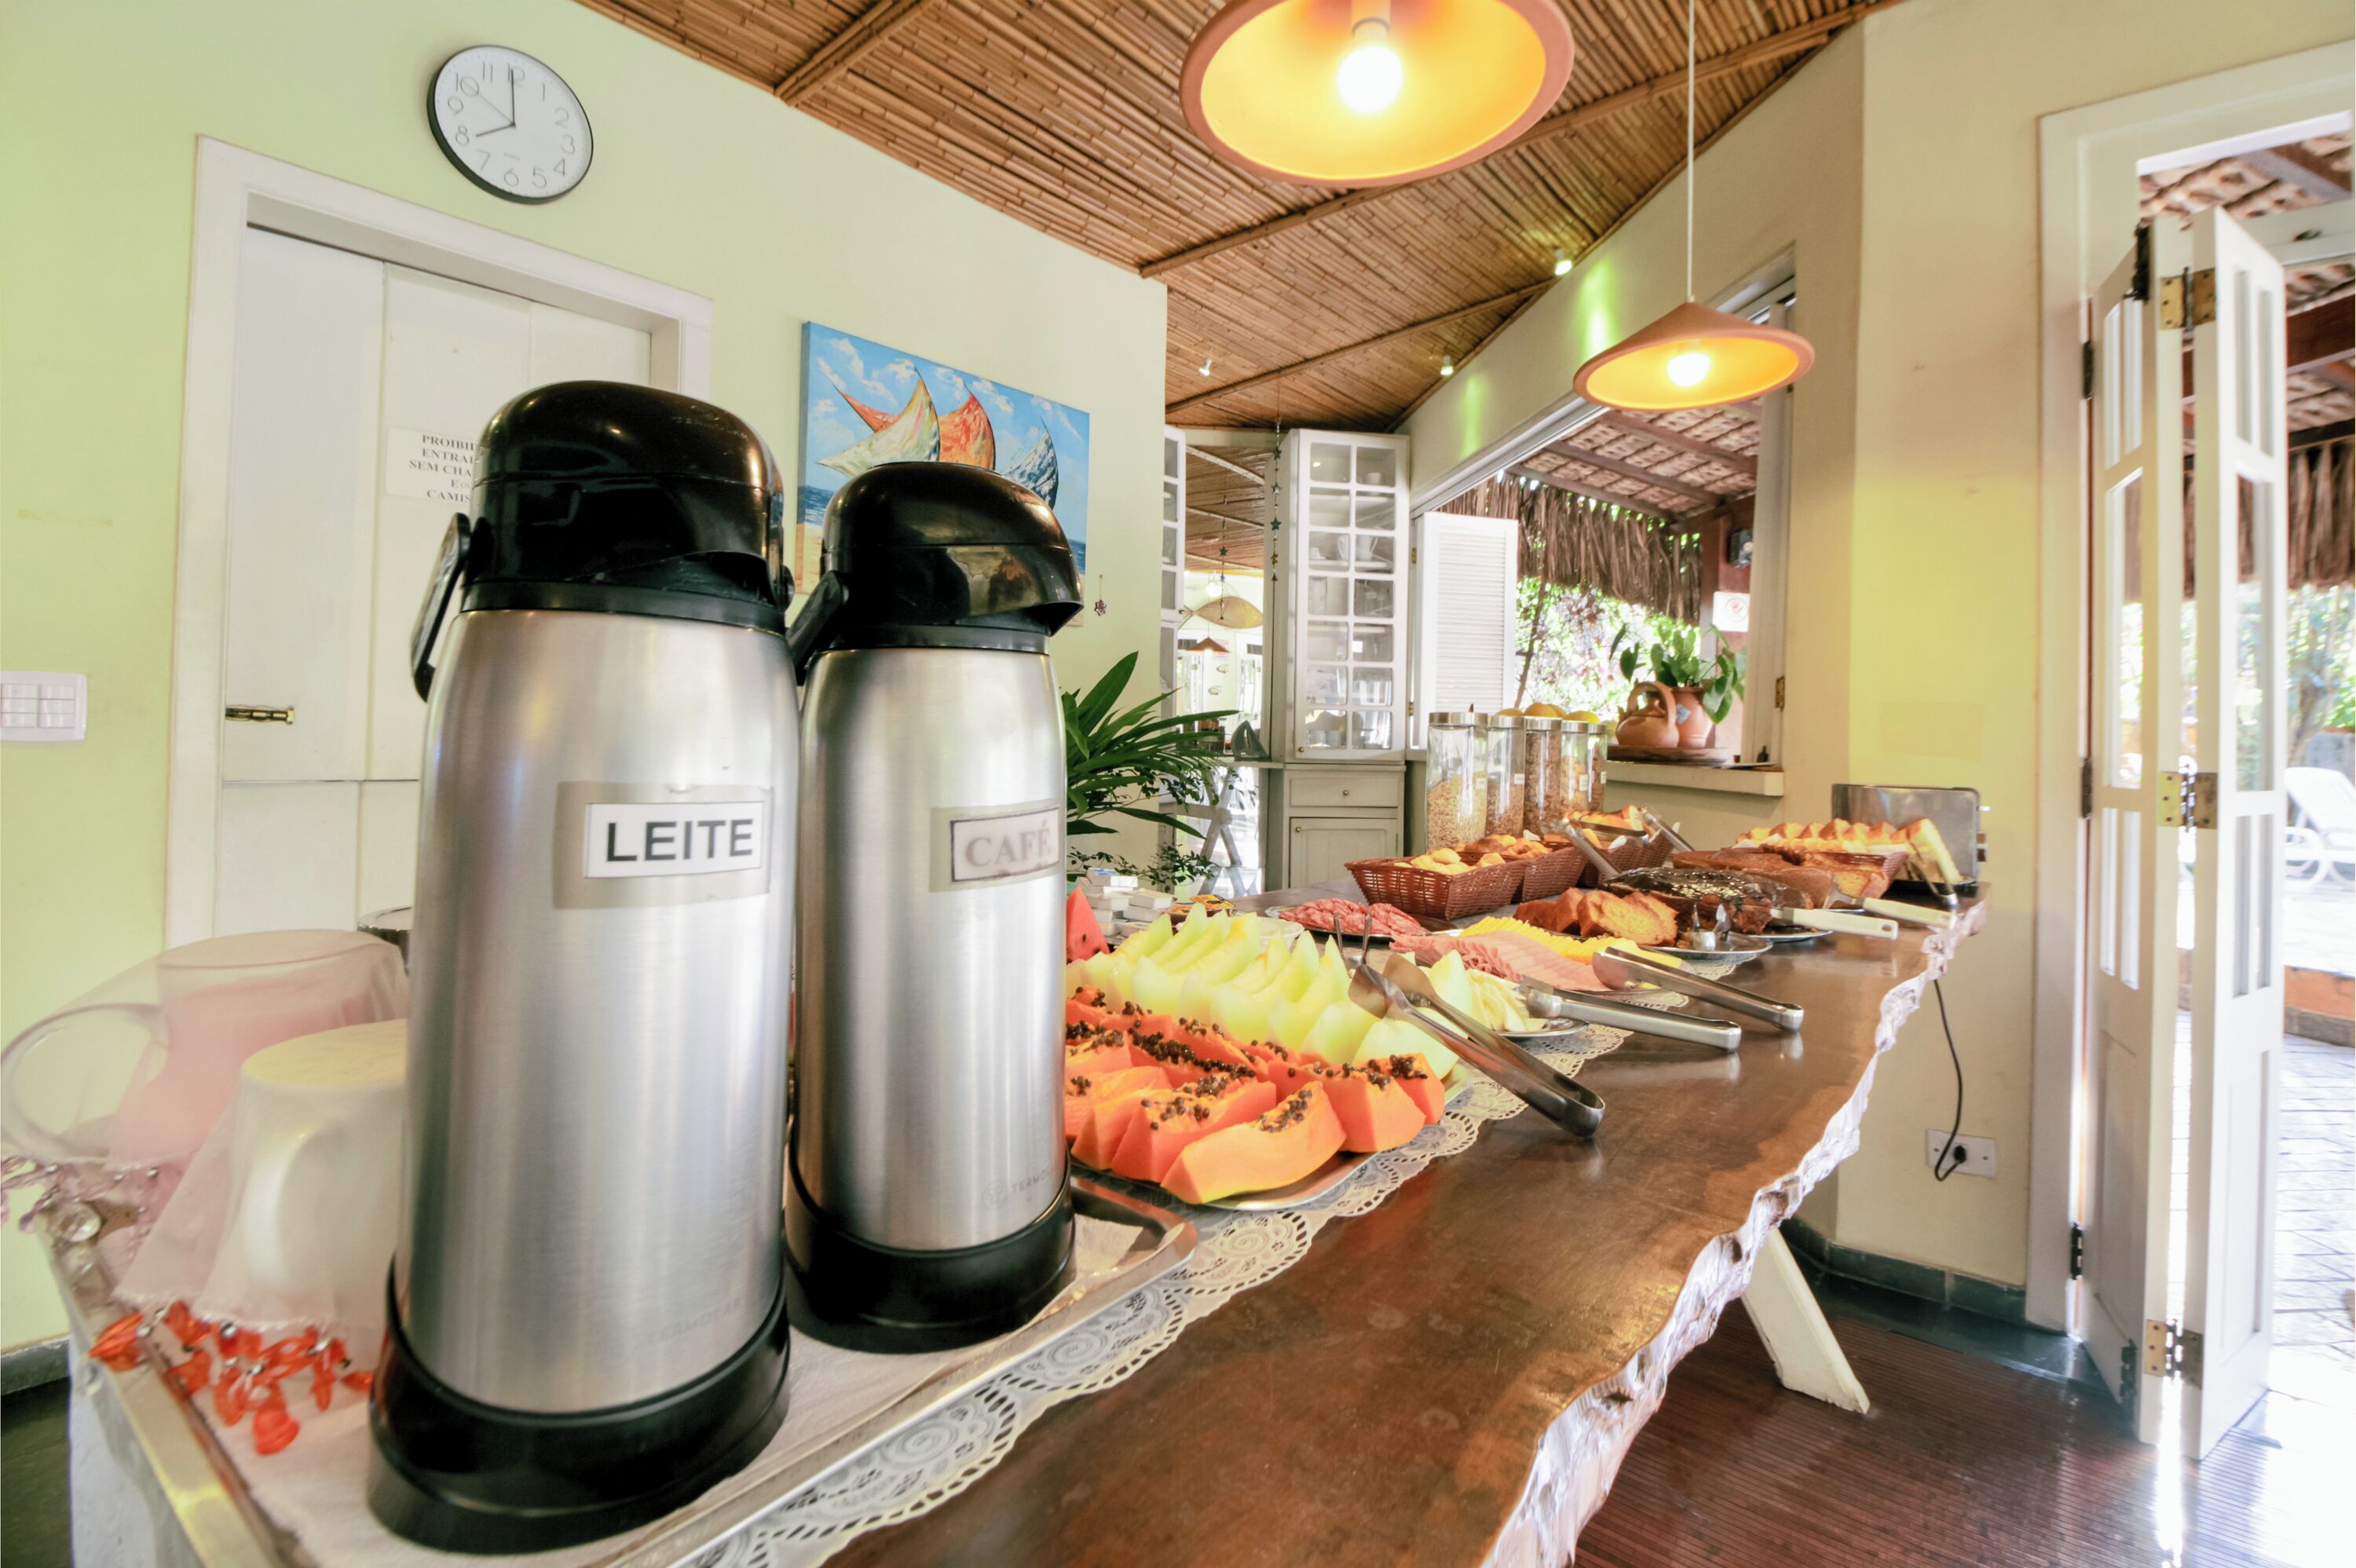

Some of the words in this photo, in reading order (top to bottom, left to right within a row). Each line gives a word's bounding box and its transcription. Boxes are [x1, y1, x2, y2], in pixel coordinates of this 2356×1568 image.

[481, 62, 493, 84] 11
[455, 72, 480, 97] 10
[448, 96, 464, 116] 9
[554, 107, 570, 129] 2
[455, 126, 470, 146] 8
[561, 133, 576, 155] 3
[475, 148, 491, 171] 7
[553, 158, 566, 177] 4
[503, 168, 519, 188] 6
[532, 166, 547, 188] 5
[409, 459, 438, 472] SEM
[606, 818, 754, 862] LEITE
[965, 819, 1052, 868] CAFÉ
